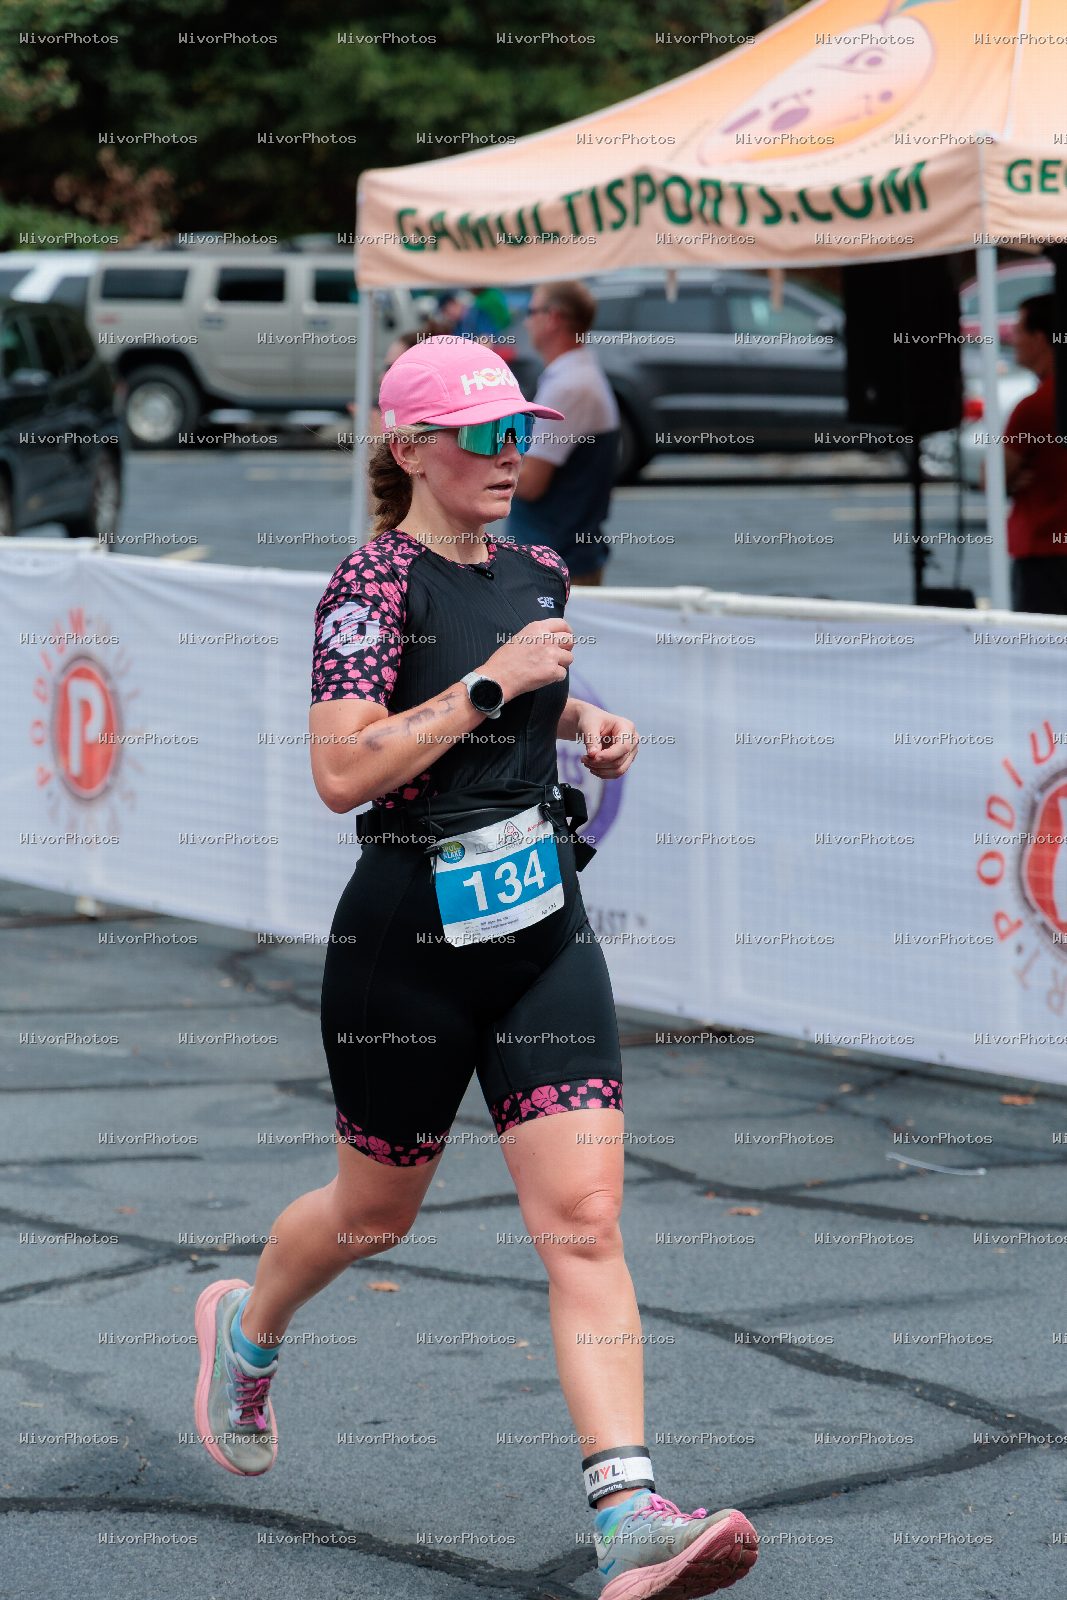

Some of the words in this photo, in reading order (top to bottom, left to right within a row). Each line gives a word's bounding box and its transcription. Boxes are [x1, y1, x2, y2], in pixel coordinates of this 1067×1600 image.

[1006, 158, 1067, 194] GE
[395, 160, 929, 253] GAMULTISPORTS.COM
[463, 849, 546, 911] 134
[588, 1465, 624, 1487] MYL
